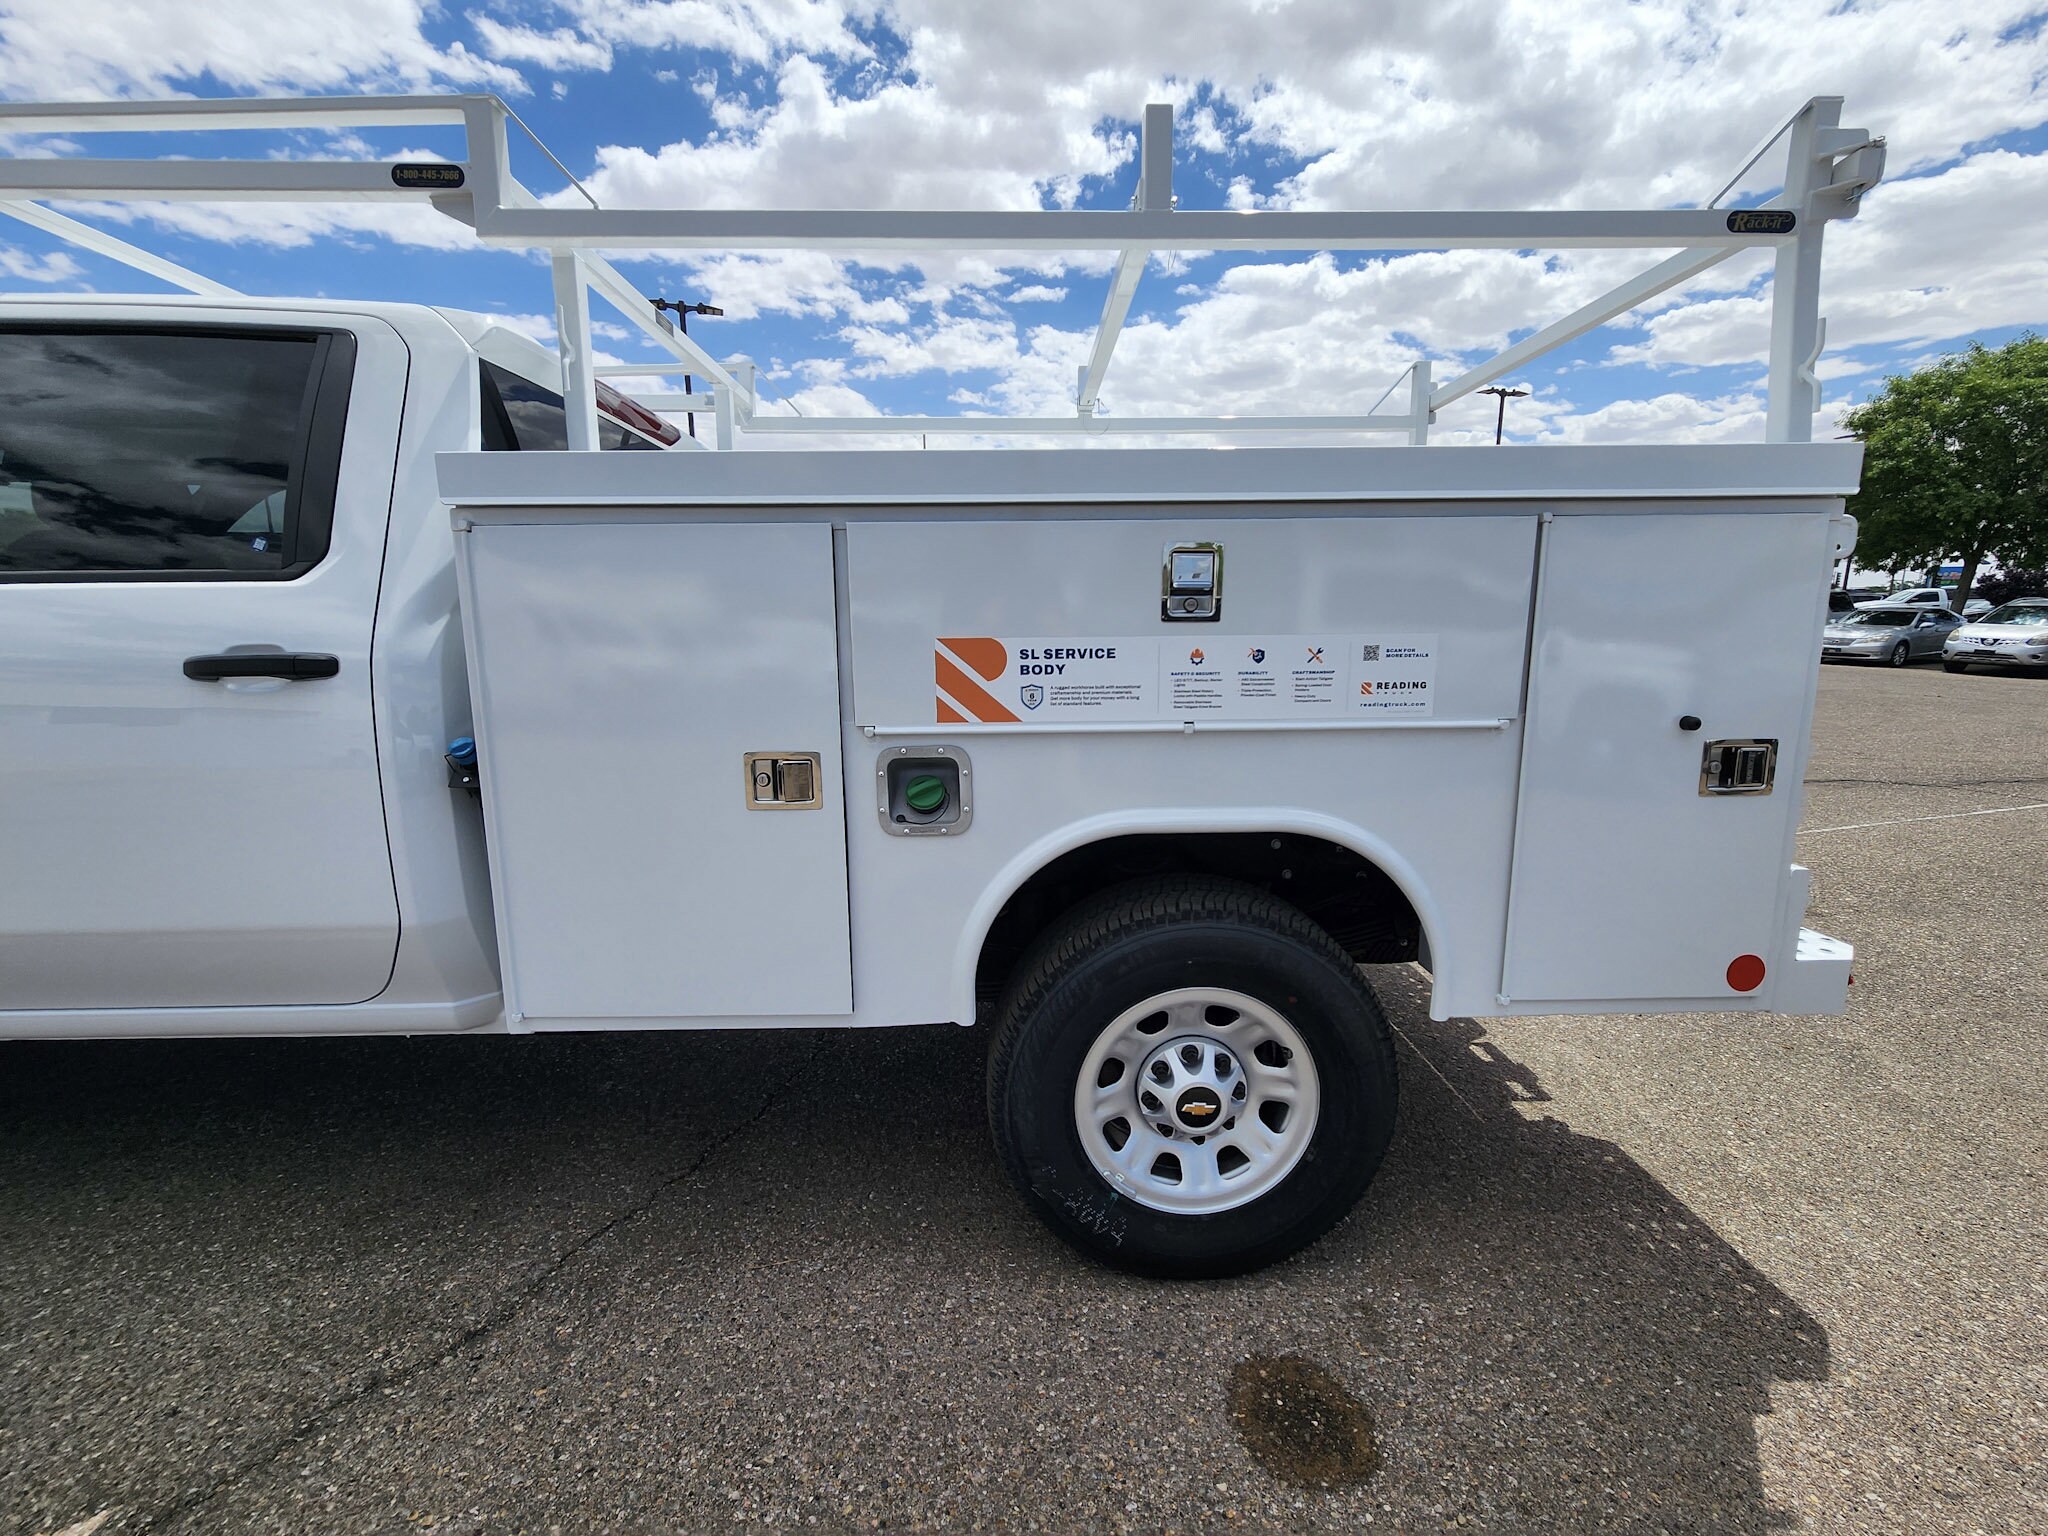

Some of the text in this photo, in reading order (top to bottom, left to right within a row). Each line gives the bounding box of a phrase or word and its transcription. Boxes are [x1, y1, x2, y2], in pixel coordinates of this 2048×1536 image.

[1019, 647, 1117, 660] SL SERVICE
[1019, 663, 1066, 676] BODY
[1376, 681, 1427, 690] READING
